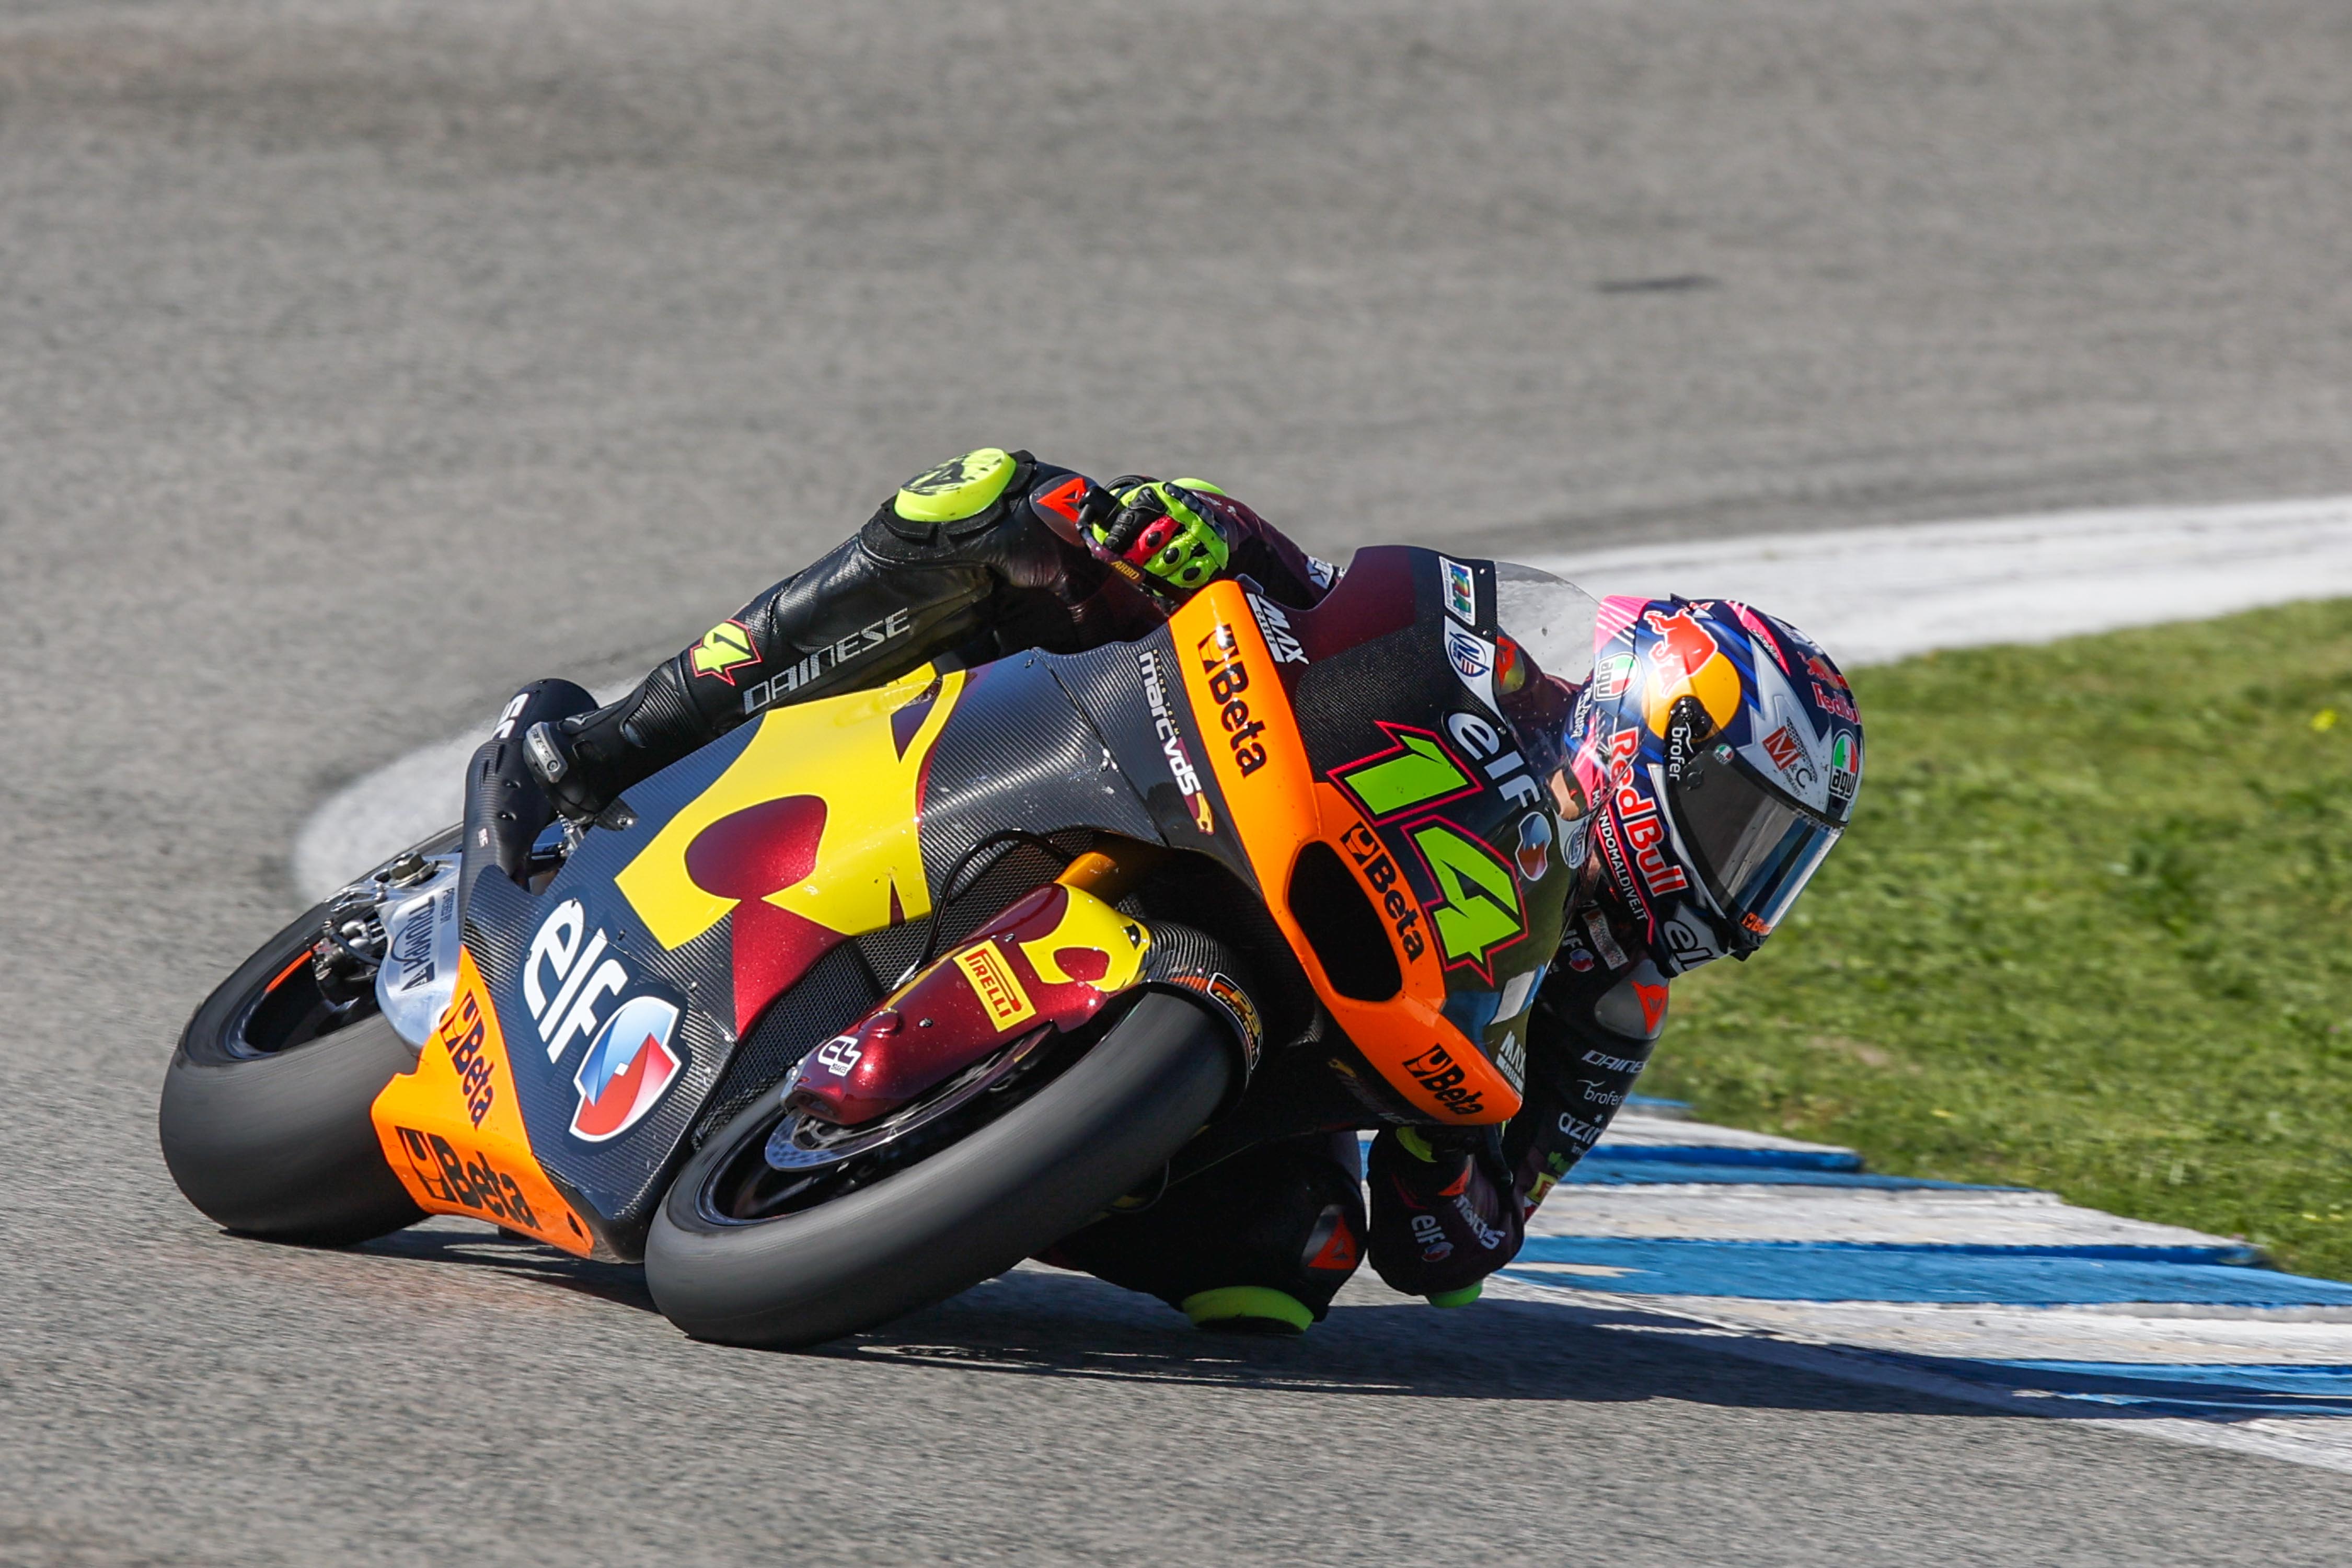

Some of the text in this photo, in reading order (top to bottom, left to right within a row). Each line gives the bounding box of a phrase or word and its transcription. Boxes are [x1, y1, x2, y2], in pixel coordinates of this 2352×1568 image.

[742, 607, 910, 715] DAINESE
[1255, 610, 1276, 645] CASES
[1257, 594, 1310, 665] MAX
[1153, 649, 1167, 694] RACING
[1166, 701, 1180, 736] TEAM
[1208, 660, 1267, 779] Beta
[1669, 727, 1687, 781] brofer
[1448, 712, 1541, 809] elf
[397, 894, 436, 975] TRIUMPH
[1363, 850, 1425, 965] Beta
[523, 898, 628, 1064] elf
[964, 947, 1022, 1019] PIRELLI
[451, 1019, 494, 1132] Beta
[1418, 1063, 1484, 1115] Beta
[1500, 1030, 1527, 1079] MAX
[426, 1132, 544, 1232] Beta
[1411, 1215, 1446, 1244] elf
